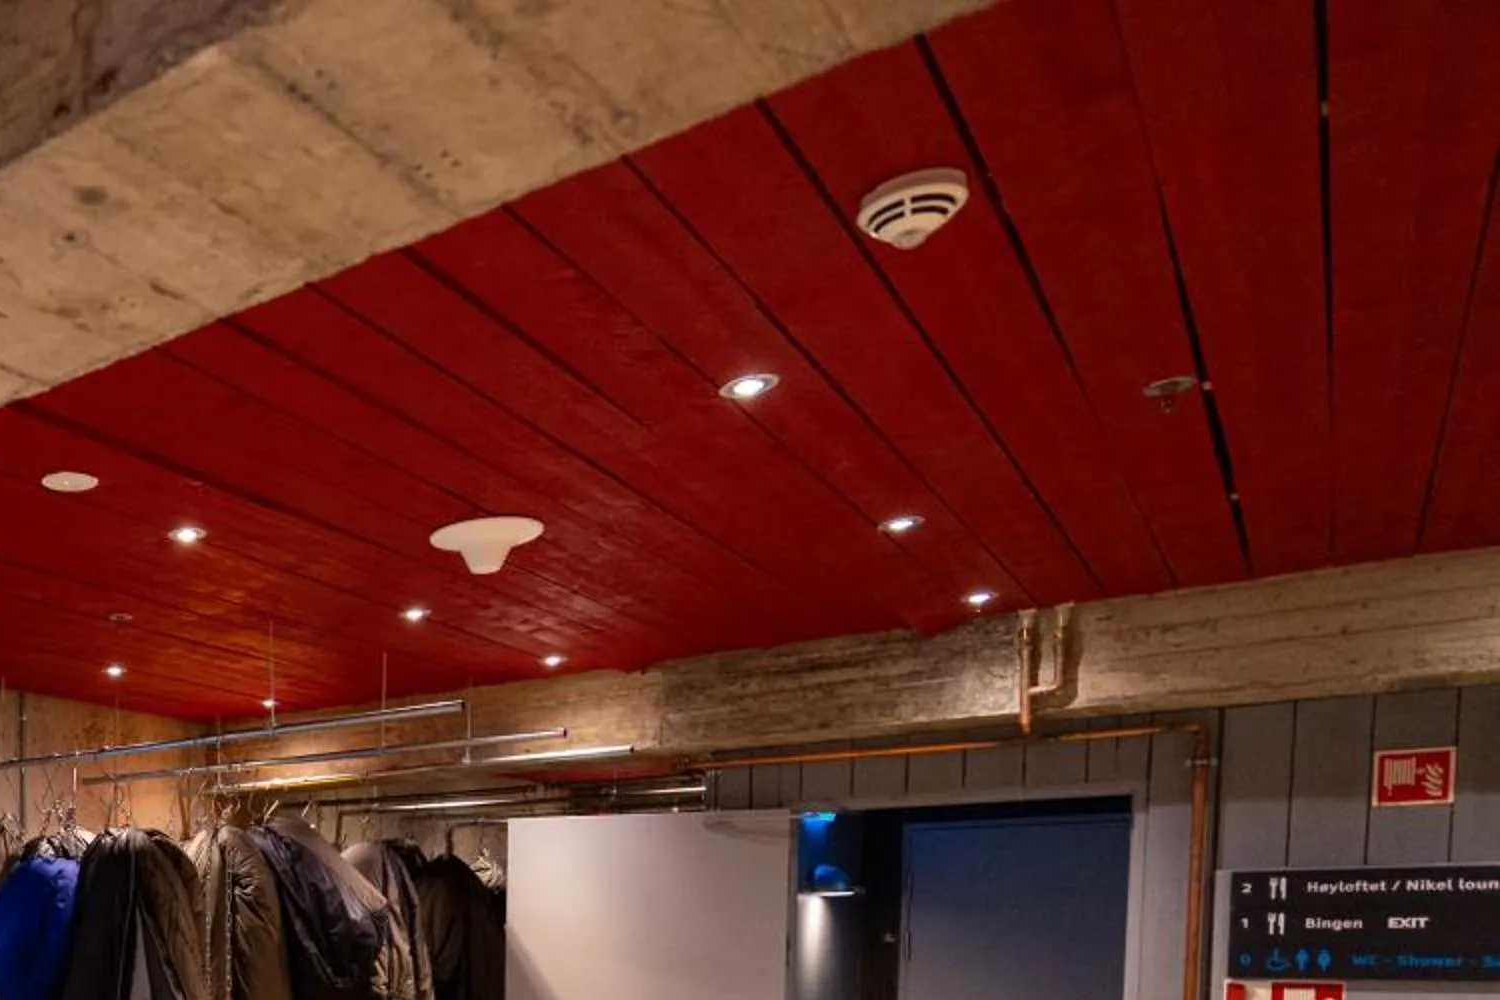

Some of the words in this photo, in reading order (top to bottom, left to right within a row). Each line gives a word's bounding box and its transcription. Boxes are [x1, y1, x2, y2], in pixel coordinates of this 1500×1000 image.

[1241, 883, 1252, 894] 2
[1306, 880, 1387, 895] Høyloftet
[1241, 918, 1249, 929] 1
[1305, 917, 1364, 931] Bingen
[1387, 917, 1429, 929] EXIT
